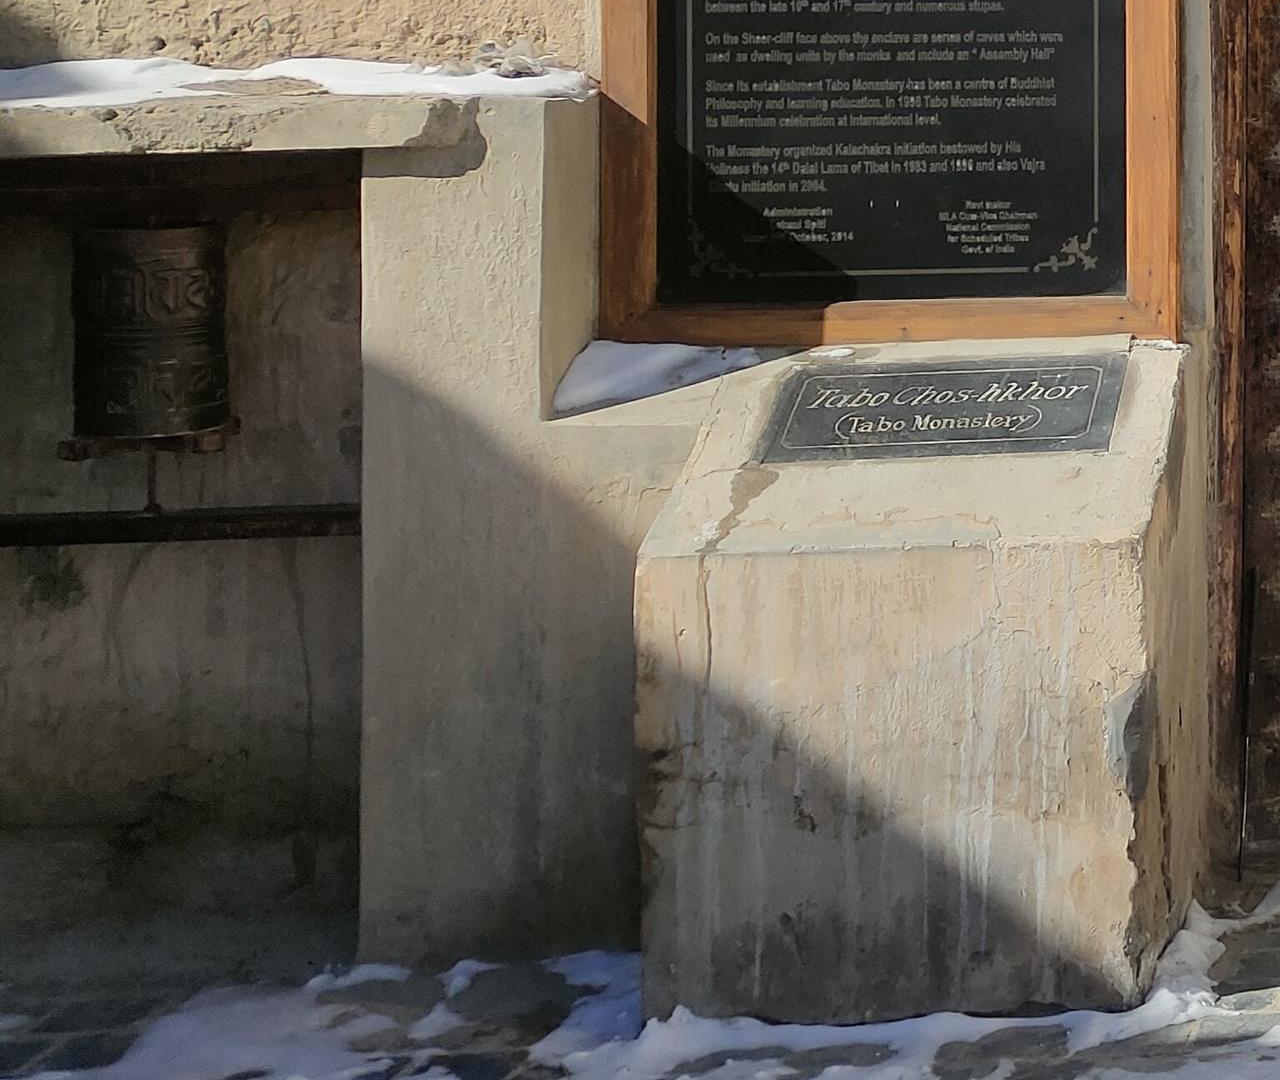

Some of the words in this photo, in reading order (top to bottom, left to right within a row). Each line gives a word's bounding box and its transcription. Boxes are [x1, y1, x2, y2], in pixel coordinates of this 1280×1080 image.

[749, 0, 767, 12] the
[810, 0, 831, 12] and
[893, 0, 914, 12] and
[915, 2, 966, 12] numerous
[704, 32, 721, 44] On
[722, 32, 740, 44] the
[819, 32, 851, 44] above
[852, 32, 870, 44] the
[963, 31, 975, 44] of
[1007, 30, 1038, 43] which
[750, 50, 793, 66] dwelling
[822, 50, 837, 65] by
[838, 50, 856, 63] the
[896, 49, 916, 62] and
[978, 48, 1029, 63] Assembly
[825, 79, 850, 92] Tabo
[852, 79, 905, 94] Monastery
[905, 78, 926, 91] has
[927, 78, 953, 90] been
[997, 77, 1009, 89] of
[1009, 76, 1055, 89] Buddhist
[765, 97, 785, 110] and
[923, 95, 949, 108] Tabo
[950, 95, 1003, 110] Monastery
[1004, 94, 1057, 107] celebrated
[914, 114, 942, 127] level.
[705, 144, 726, 157] The
[727, 144, 781, 160] Monastery
[834, 143, 892, 156] Kalachakra
[989, 142, 1003, 157] by
[752, 162, 769, 175] the
[792, 162, 819, 175] Dalai
[820, 161, 849, 174] Lama
[850, 161, 862, 174] of
[863, 161, 890, 173] Tibet
[928, 160, 949, 172] and
[975, 159, 996, 172] and
[1019, 158, 1046, 174] Vajra
[806, 387, 891, 408] Tabo
[834, 412, 904, 440] (Tabo
[912, 405, 1043, 434] Monastery)
